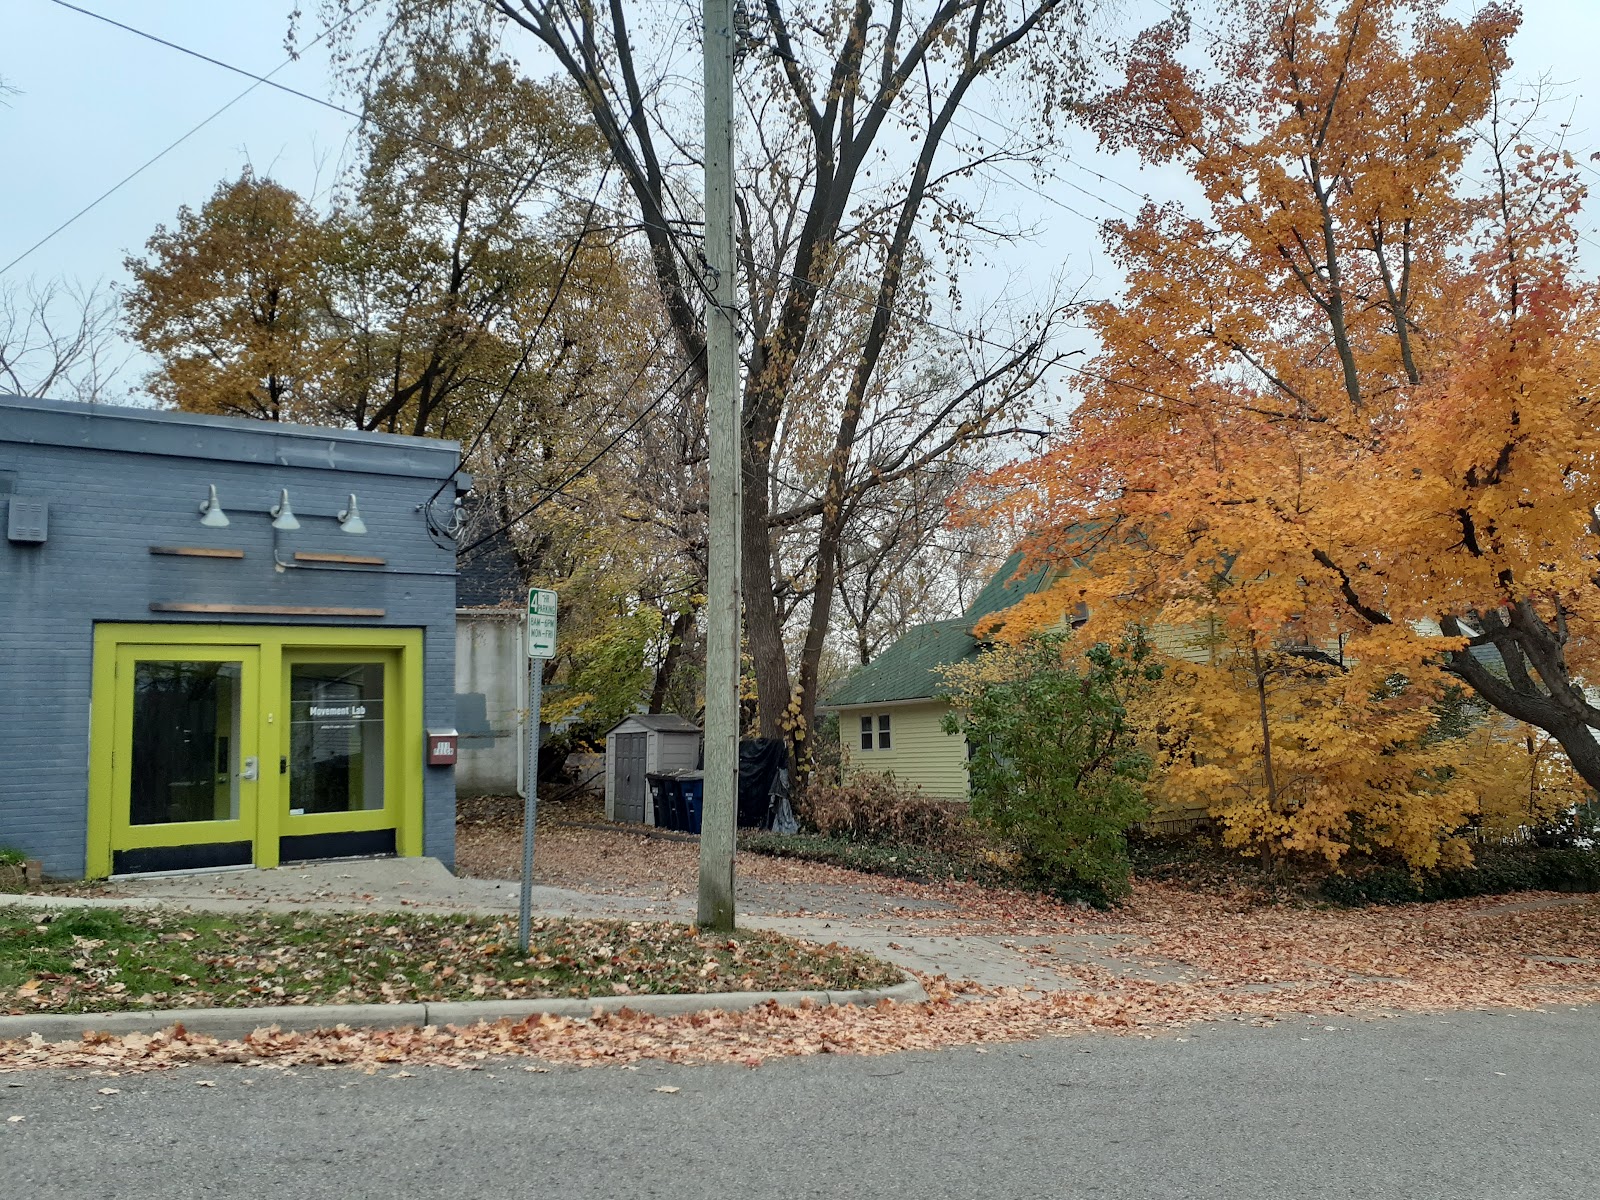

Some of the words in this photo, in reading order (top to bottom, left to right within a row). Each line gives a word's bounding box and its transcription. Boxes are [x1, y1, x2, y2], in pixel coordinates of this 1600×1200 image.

[531, 593, 538, 612] 4
[544, 594, 550, 602] HR
[538, 604, 555, 614] PARKING
[531, 630, 554, 638] MON-FRI
[310, 706, 350, 716] Movement
[352, 706, 366, 714] Lab
